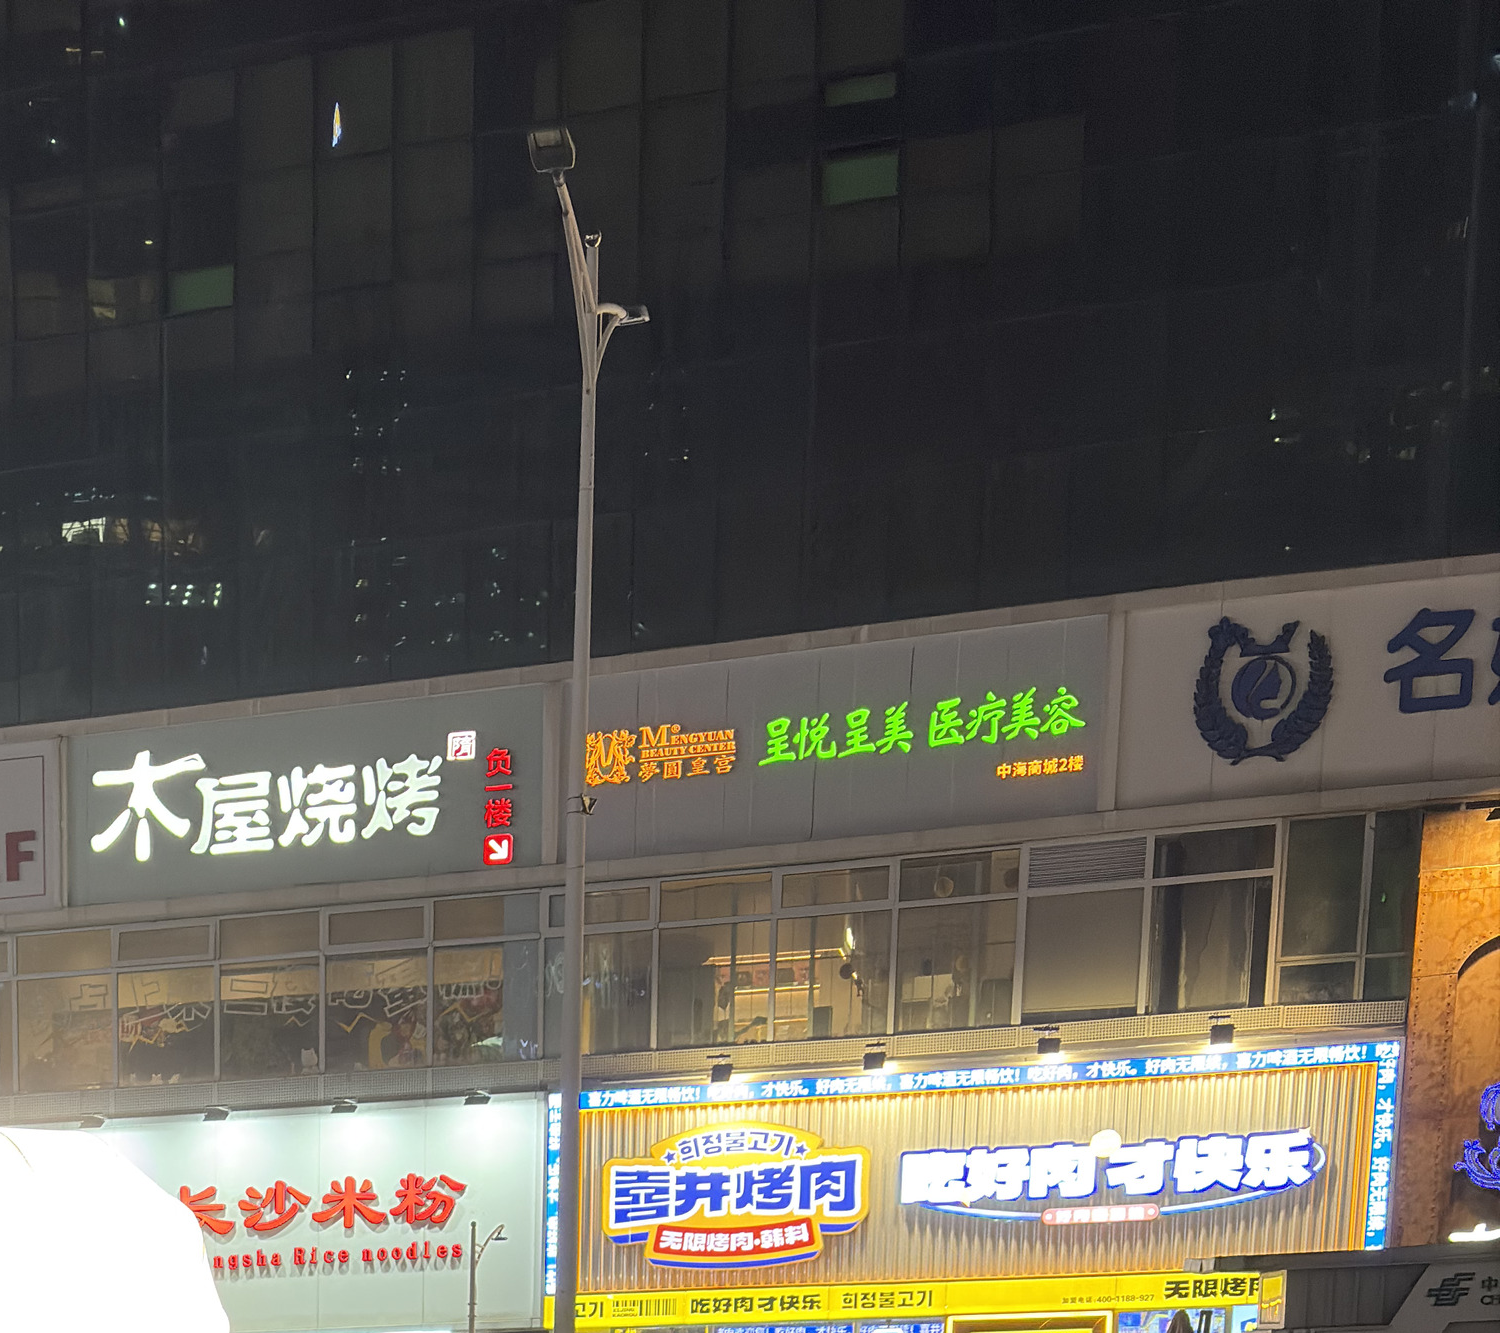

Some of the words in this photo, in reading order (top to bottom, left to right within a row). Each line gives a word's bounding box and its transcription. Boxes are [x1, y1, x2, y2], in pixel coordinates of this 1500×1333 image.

[1383, 607, 1500, 715] 名
[640, 746, 686, 758] BEAUTY
[688, 741, 736, 755] CENTER
[758, 701, 915, 767] 呈悦呈美
[928, 687, 1086, 748] 医疗美容
[484, 746, 514, 829] 负一楼
[996, 753, 1085, 780] 中海商城2楼
[90, 749, 444, 862] 木屋烧烤
[678, 1131, 794, 1161] 희정불고기
[180, 1173, 467, 1235] 长沙米粉
[614, 1159, 857, 1224] 喜井烤肉
[293, 1246, 349, 1265] Rice
[362, 1241, 462, 1262] noodles
[690, 1293, 823, 1315] 吃好肉才快乐
[841, 1289, 934, 1310] 희정불고기
